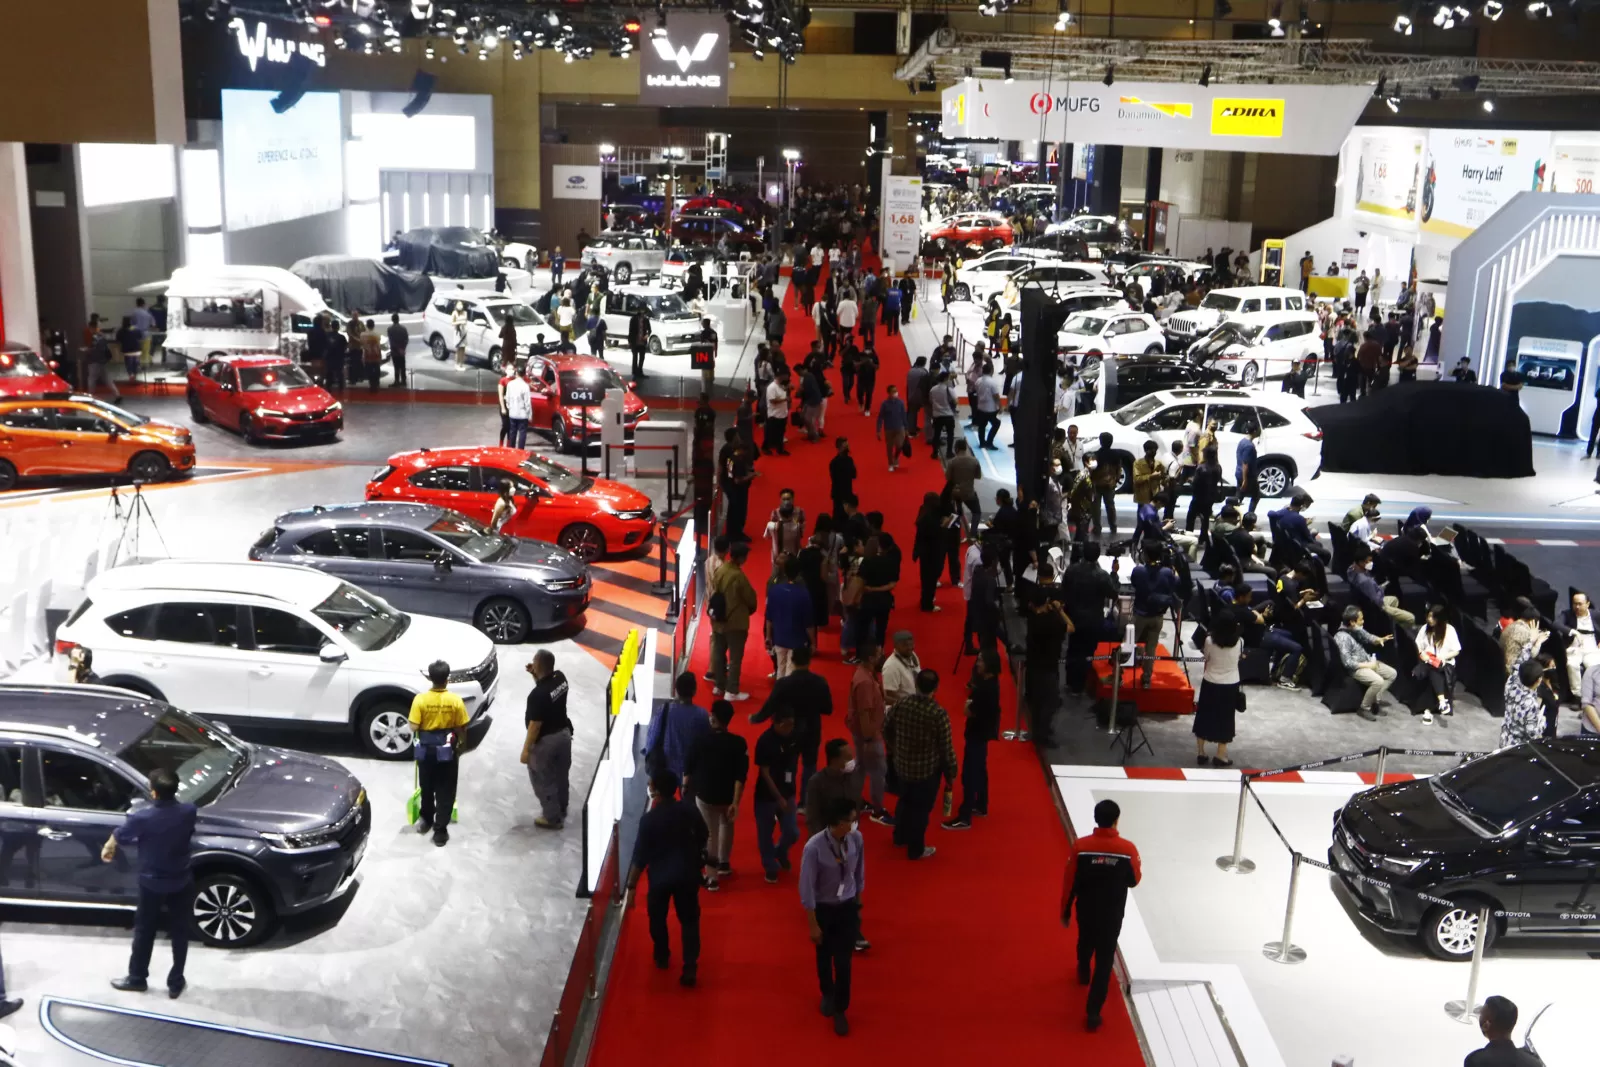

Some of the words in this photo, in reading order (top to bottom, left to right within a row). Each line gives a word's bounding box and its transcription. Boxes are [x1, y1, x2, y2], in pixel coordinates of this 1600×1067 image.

[646, 74, 721, 88] WULING
[1055, 97, 1100, 113] MUFG
[1117, 107, 1162, 120] Danamon
[1219, 107, 1276, 118] ADIRA
[1462, 164, 1484, 185] Harry
[1485, 165, 1504, 182] Latif
[1575, 178, 1593, 194] 500
[891, 213, 915, 225] 1,68
[695, 352, 709, 363] IN
[571, 391, 593, 400] 041
[1308, 859, 1331, 871] TOYOTA
[1366, 877, 1391, 889] TOYOTA
[1428, 895, 1455, 908] TOYOTA
